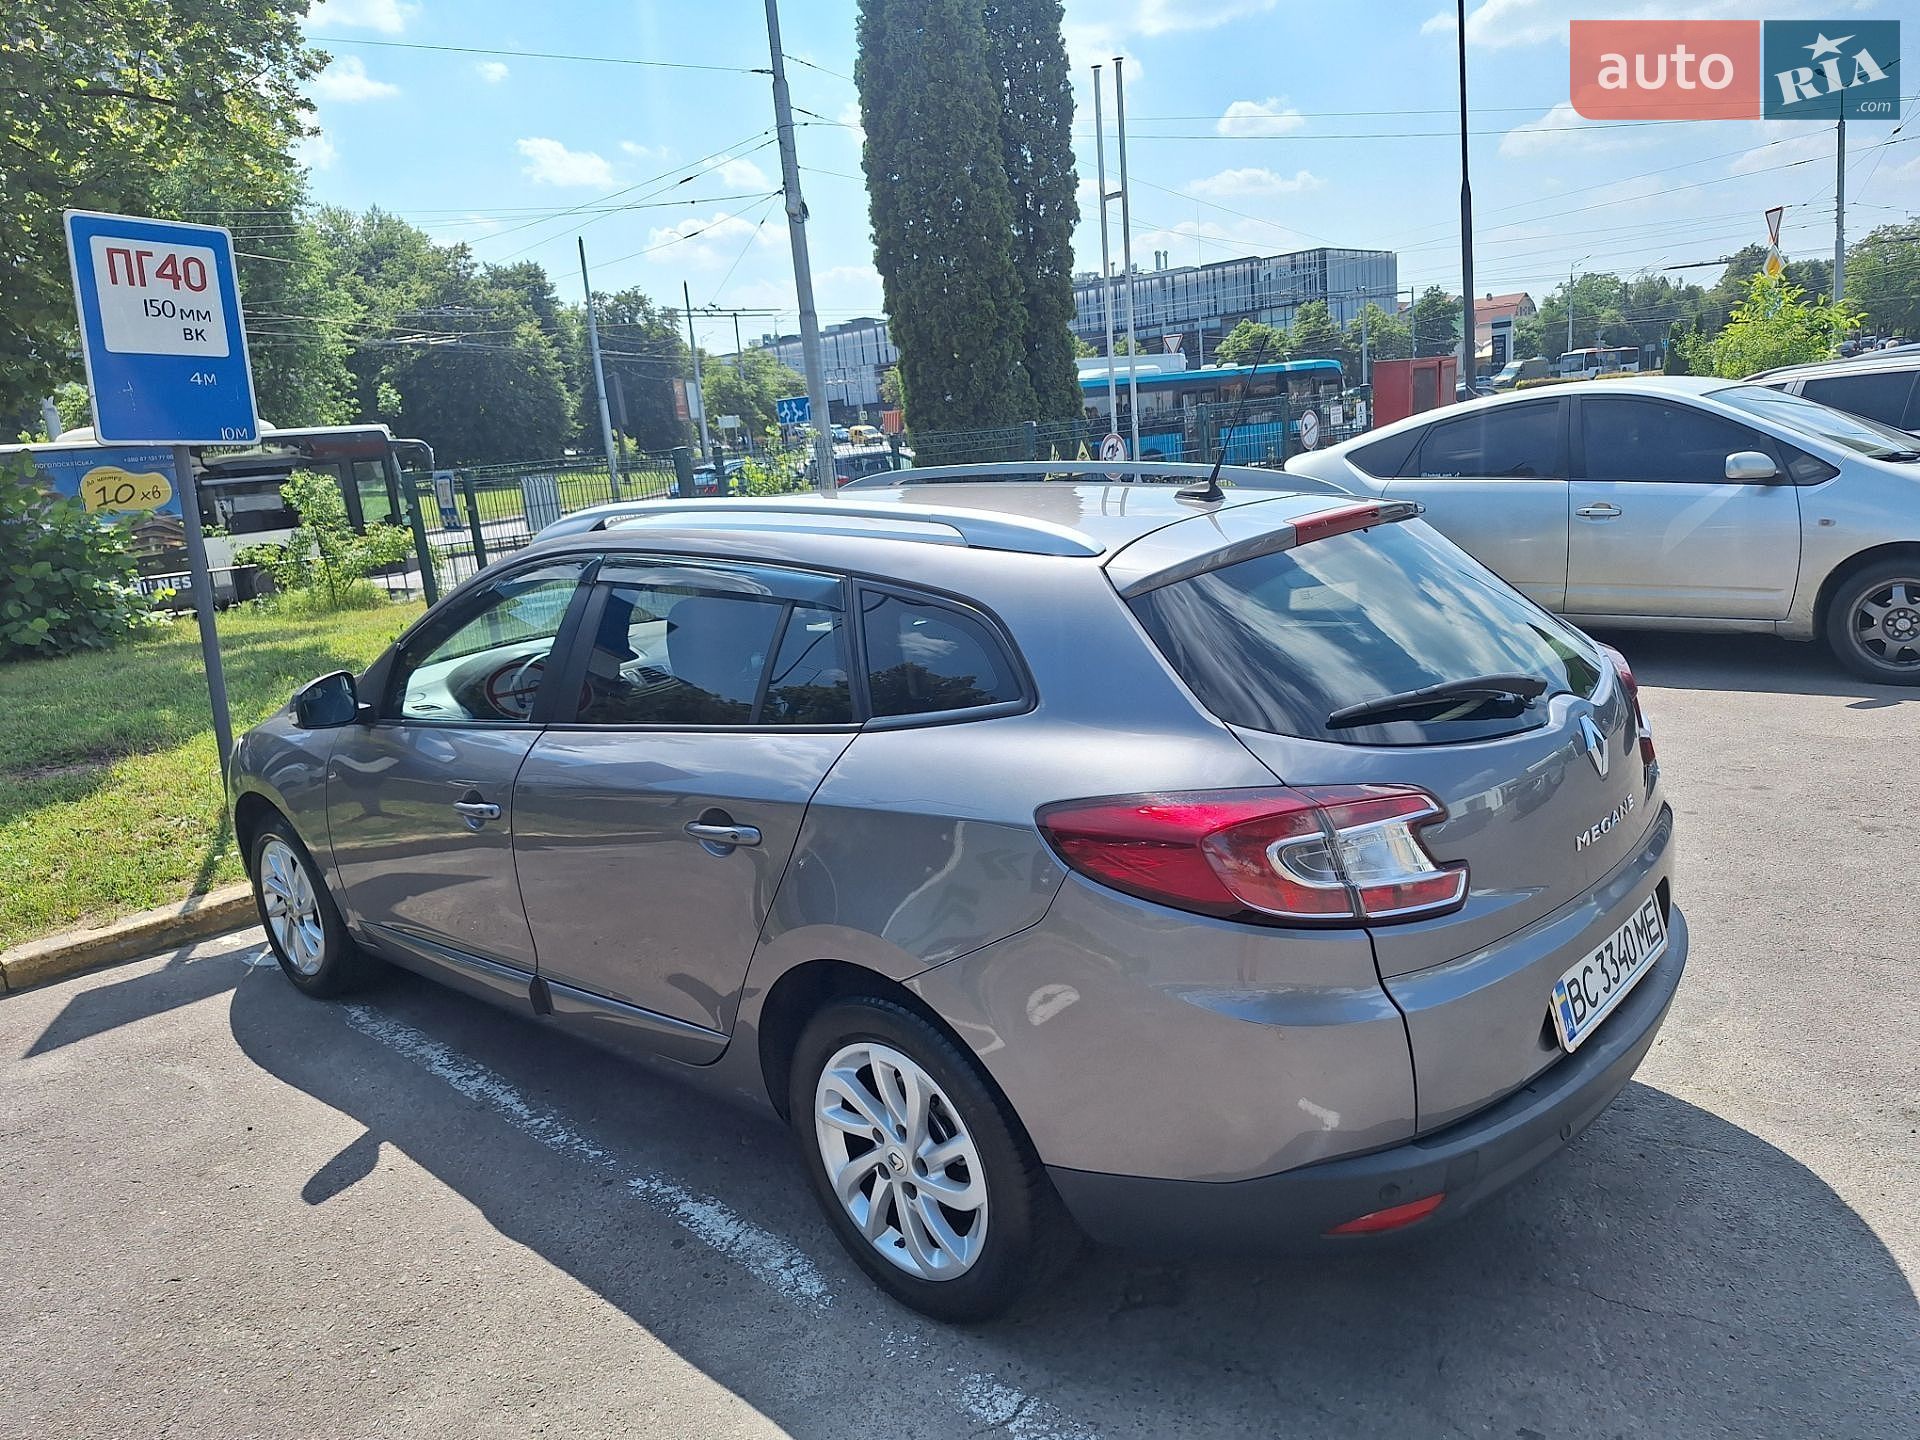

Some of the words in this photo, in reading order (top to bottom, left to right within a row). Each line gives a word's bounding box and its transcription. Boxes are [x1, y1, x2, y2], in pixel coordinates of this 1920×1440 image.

[105, 247, 207, 292] ПГ40
[143, 298, 176, 318] 150
[95, 483, 135, 507] 10
[1575, 792, 1635, 852] MEGANE
[1595, 926, 1637, 994] 3340
